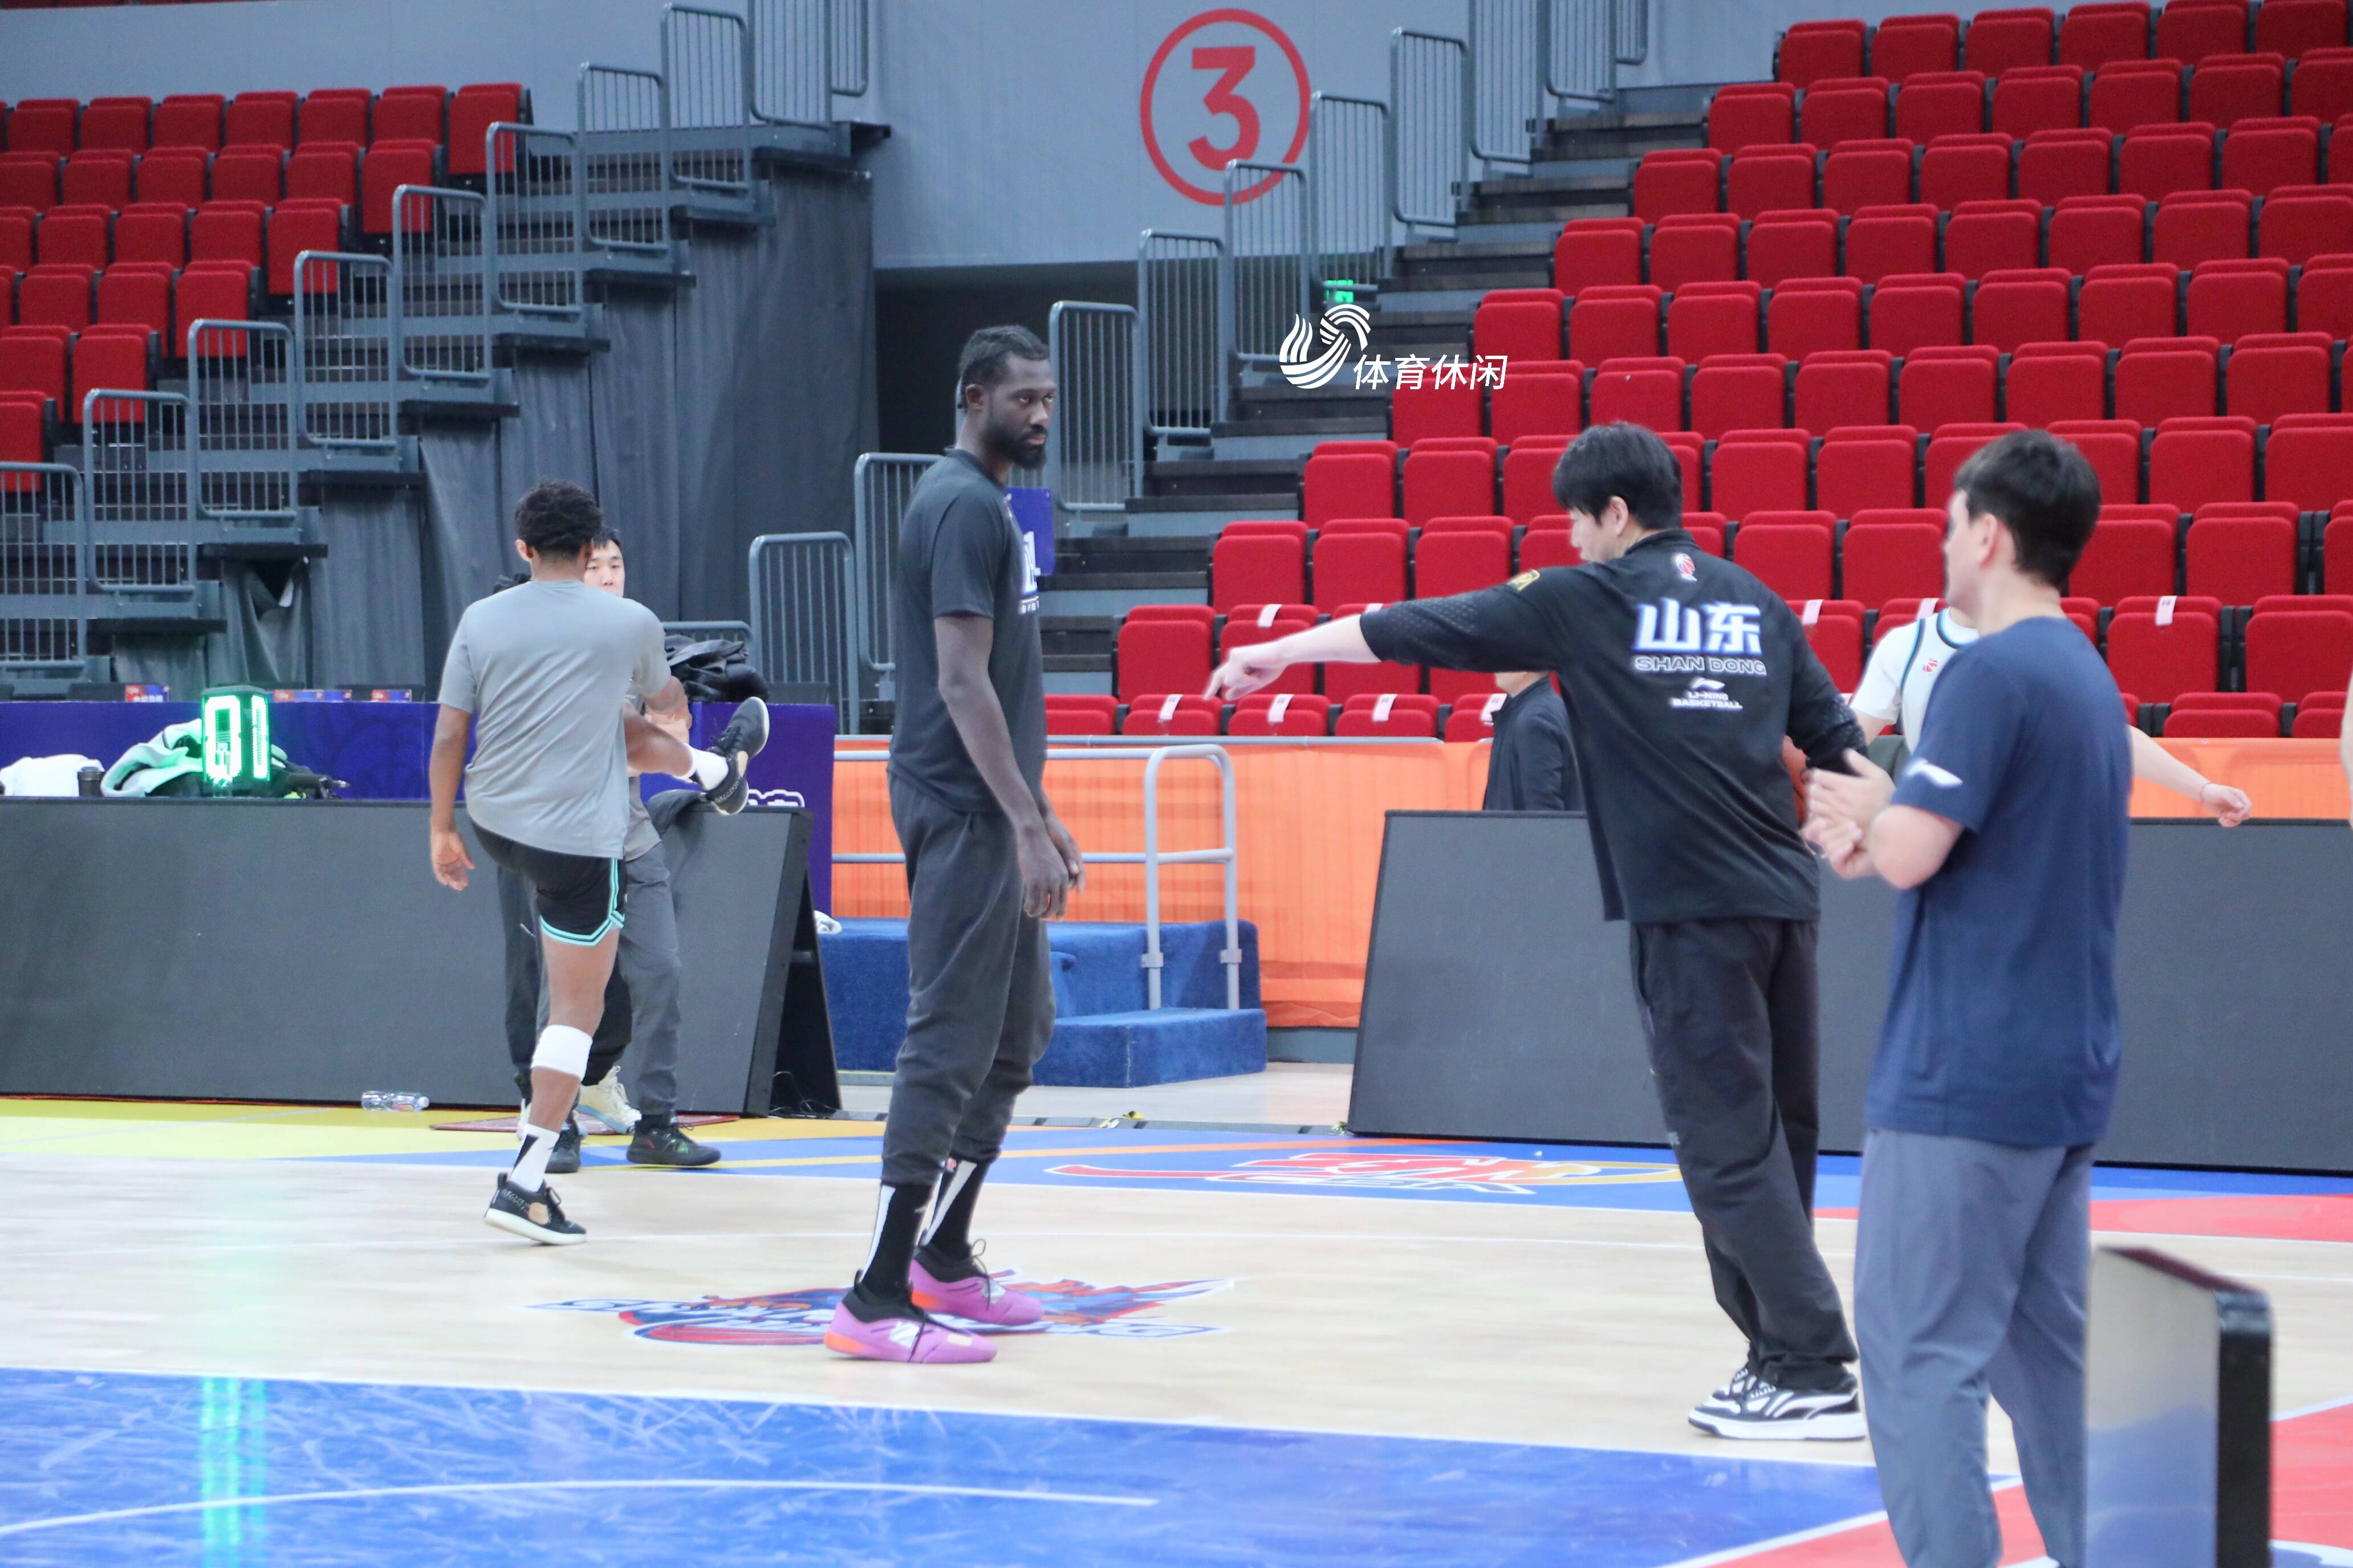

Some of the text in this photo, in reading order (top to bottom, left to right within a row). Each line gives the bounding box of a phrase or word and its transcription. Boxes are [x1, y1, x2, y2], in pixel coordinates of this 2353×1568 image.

[1188, 45, 1261, 172] 3
[1633, 597, 1763, 655] 山东
[1635, 656, 1767, 676] SHAN DONG
[1670, 697, 1744, 710] BASKETBALL
[1686, 690, 1729, 701] LI-NING
